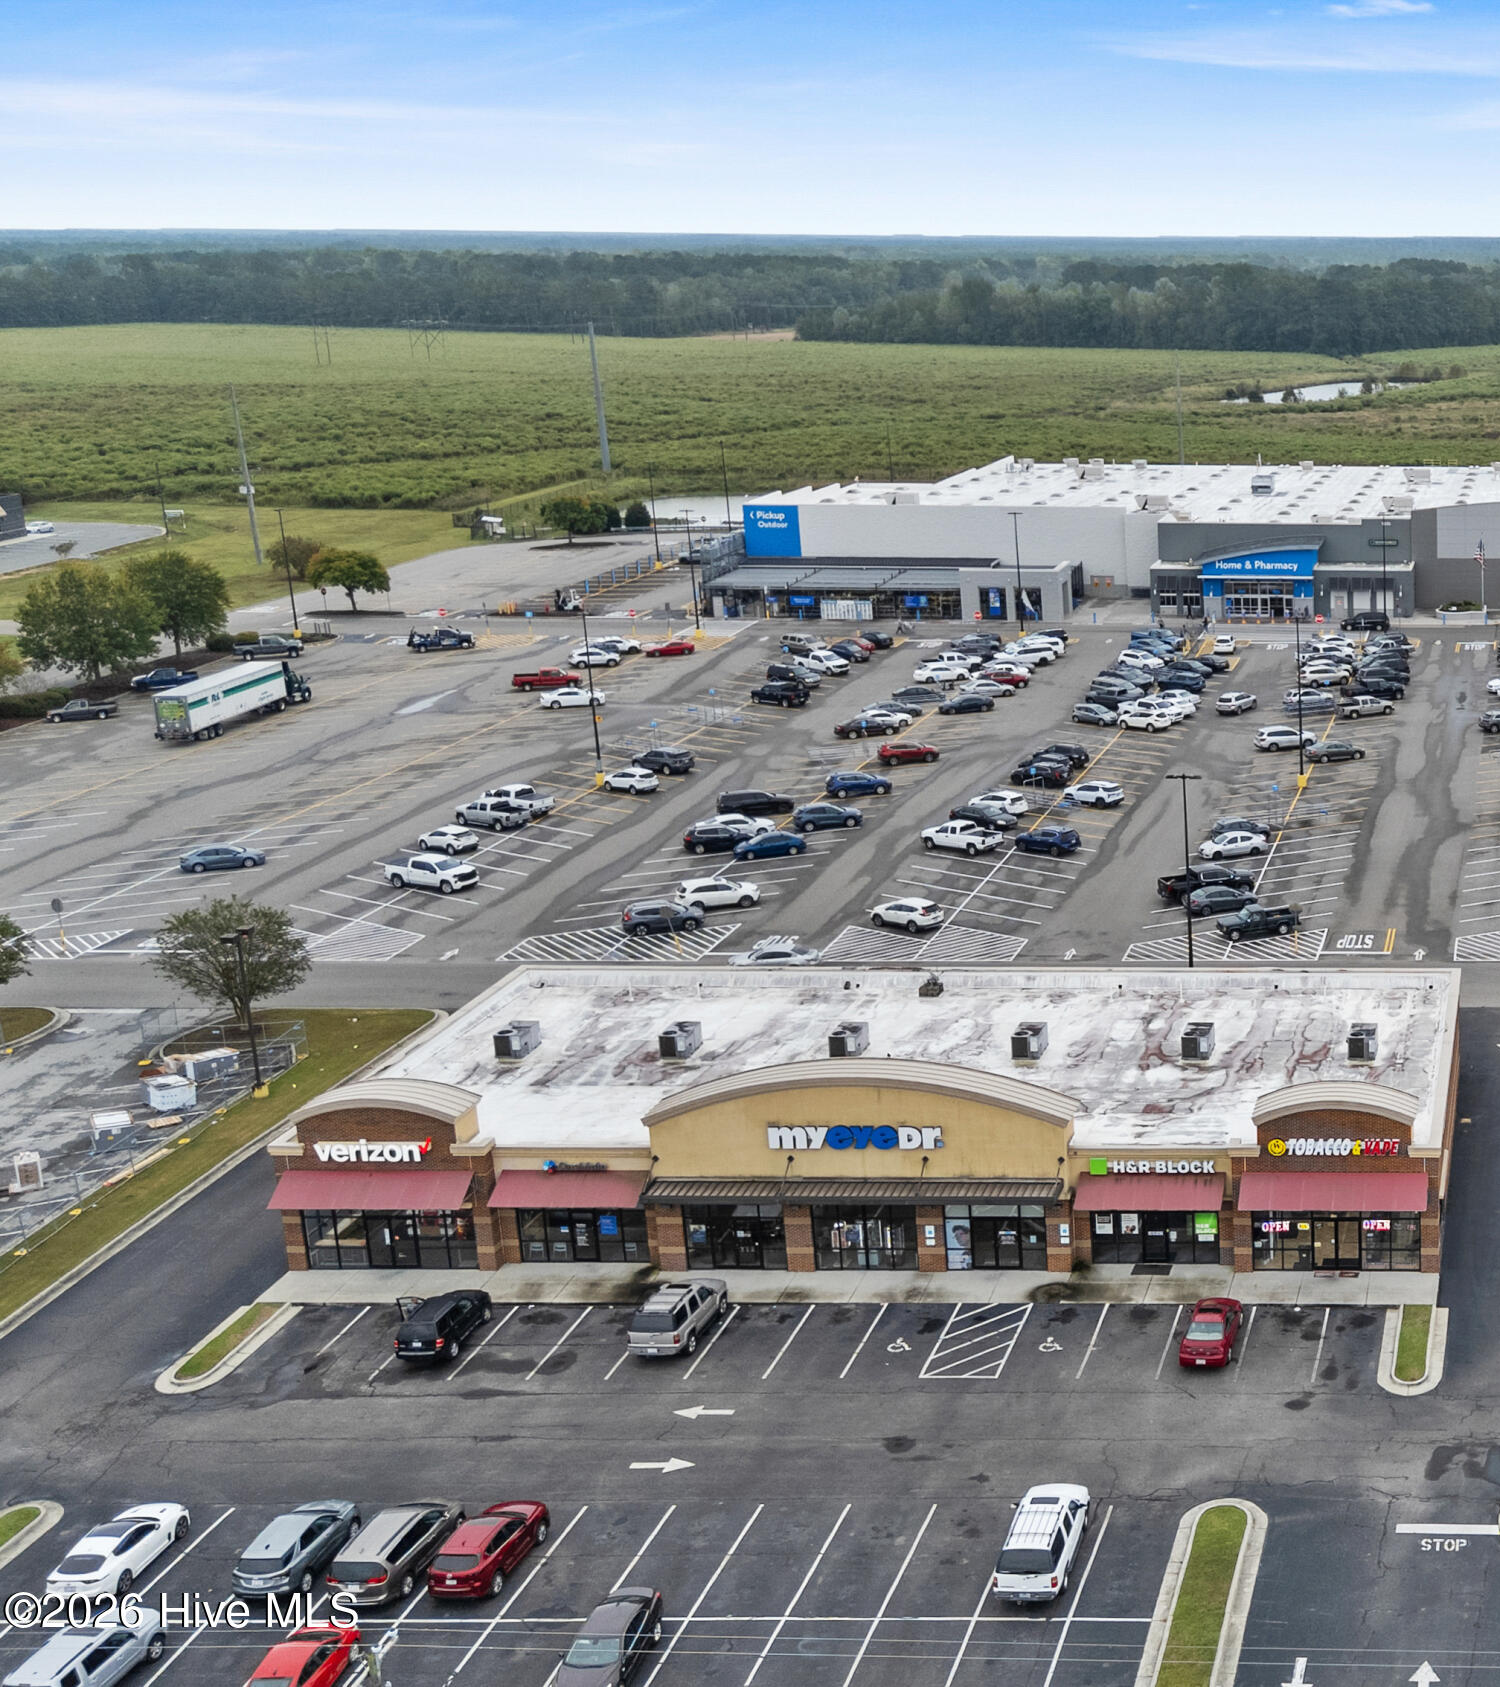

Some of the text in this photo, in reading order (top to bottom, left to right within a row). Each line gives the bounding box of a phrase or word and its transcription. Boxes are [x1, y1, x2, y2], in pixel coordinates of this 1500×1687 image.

[756, 511, 786, 521] Pickup
[757, 520, 788, 528] Outdoor
[1215, 560, 1298, 572] Home & Pharmacy
[1336, 934, 1374, 949] STOP
[313, 1139, 422, 1162] verizon
[1287, 1138, 1400, 1156] TOBACCO & VAPE
[1113, 1160, 1216, 1174] H&R BLOCK
[1262, 1221, 1290, 1232] OPEN
[1363, 1220, 1391, 1231] OPEN
[1420, 1538, 1467, 1552] STOP
